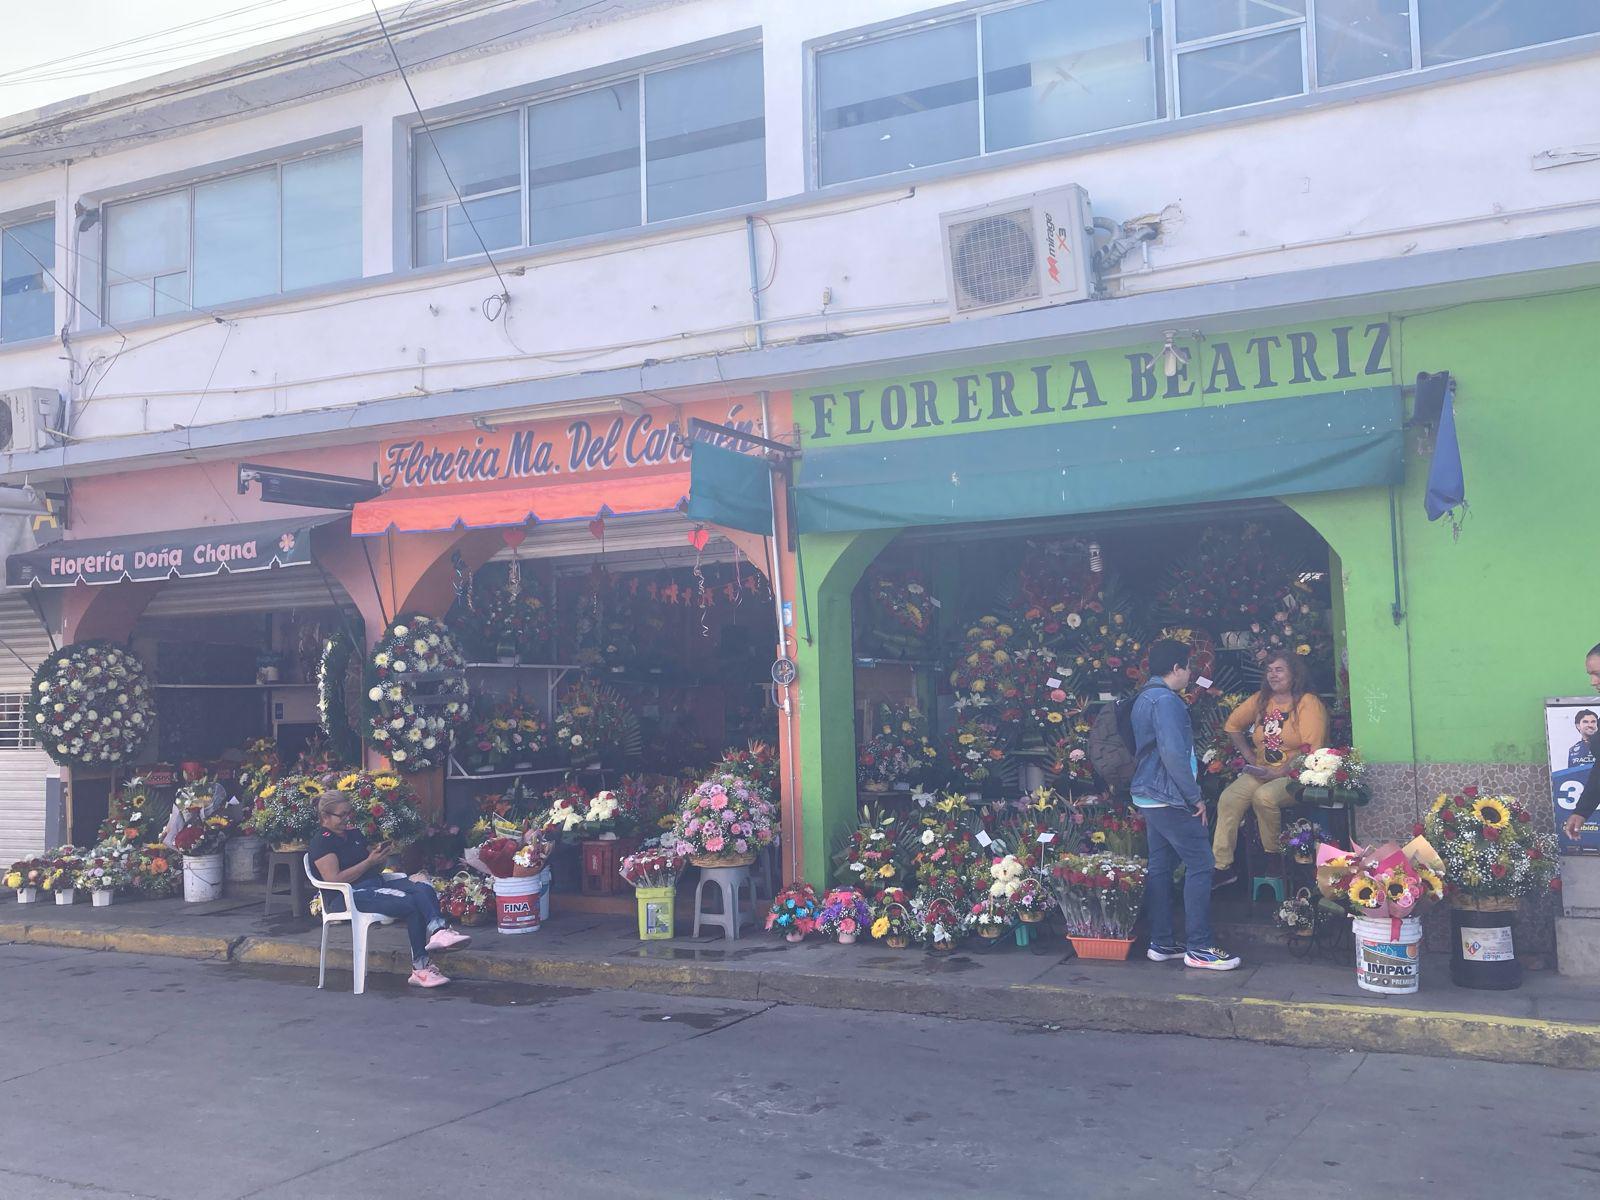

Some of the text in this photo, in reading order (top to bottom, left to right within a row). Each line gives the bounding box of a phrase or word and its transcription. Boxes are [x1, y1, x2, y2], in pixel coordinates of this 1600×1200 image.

[1044, 212, 1056, 258] mirage
[1056, 227, 1071, 254] X3
[809, 322, 1393, 440] FLORERIA BEATRIZ
[381, 436, 500, 489] Floreria
[499, 430, 560, 479] Ma.
[566, 416, 624, 474] Del
[50, 550, 124, 576] Florería
[134, 547, 183, 569] Doña
[193, 540, 257, 564] Chana
[503, 902, 530, 912] FINA
[1367, 962, 1412, 976] IMPAC
